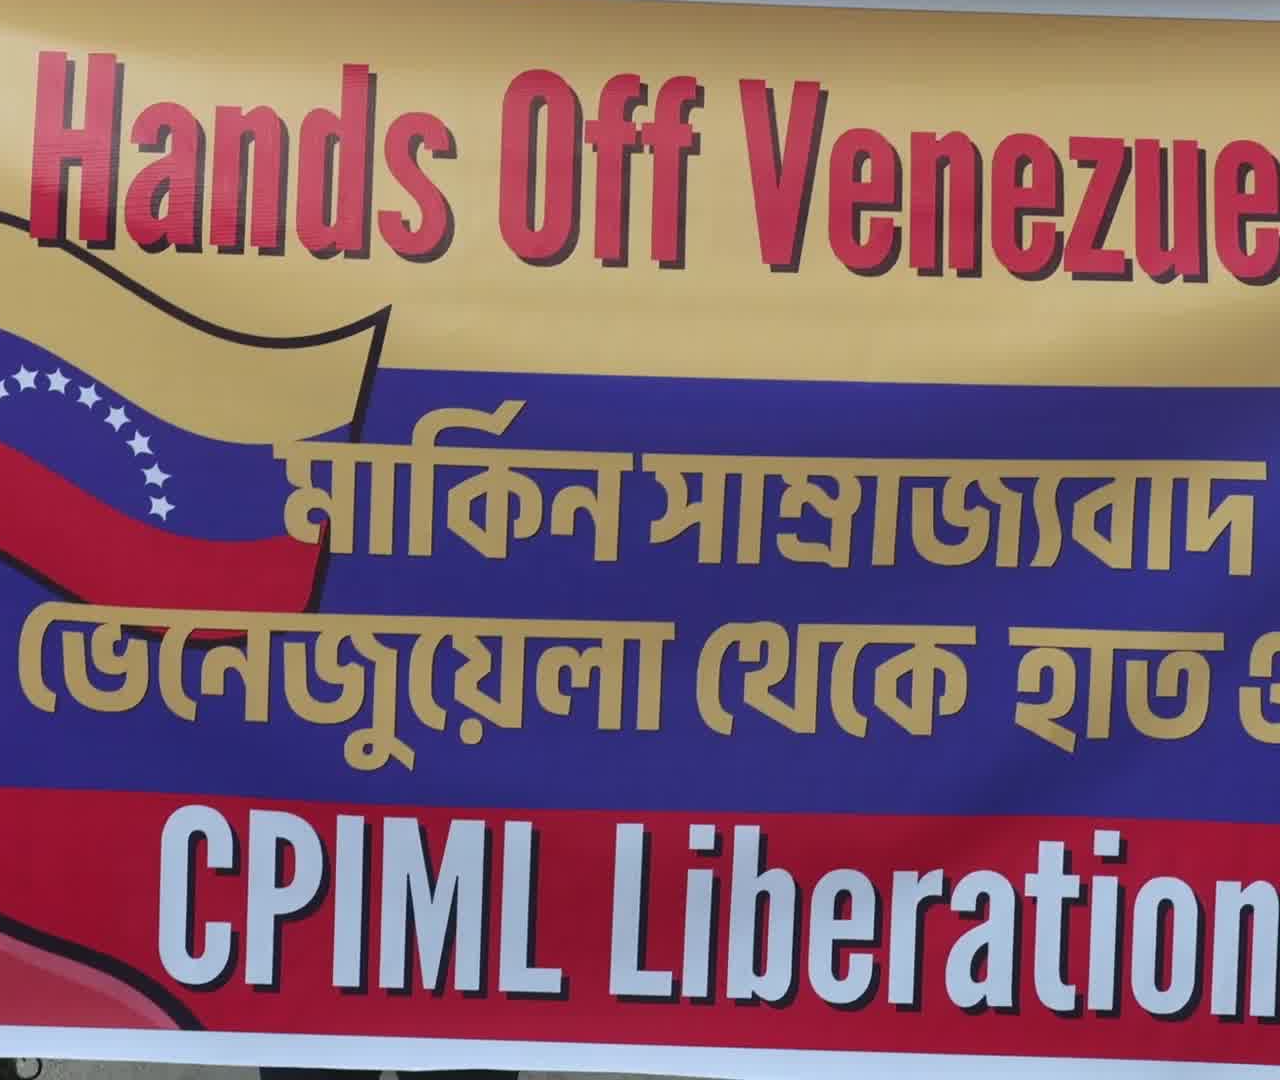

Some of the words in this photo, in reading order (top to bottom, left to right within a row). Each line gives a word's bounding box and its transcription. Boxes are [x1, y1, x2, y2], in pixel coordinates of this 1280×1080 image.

[28, 49, 456, 263] Hands
[496, 68, 704, 272] Off
[274, 402, 632, 572] মার্কিন
[646, 456, 1268, 578] সাম্রাজ্যবাদ
[16, 604, 676, 772] ভেনেজুয়েলা
[698, 620, 980, 728] থেকে
[1010, 626, 1226, 752] হাত
[156, 804, 566, 998] CPIML
